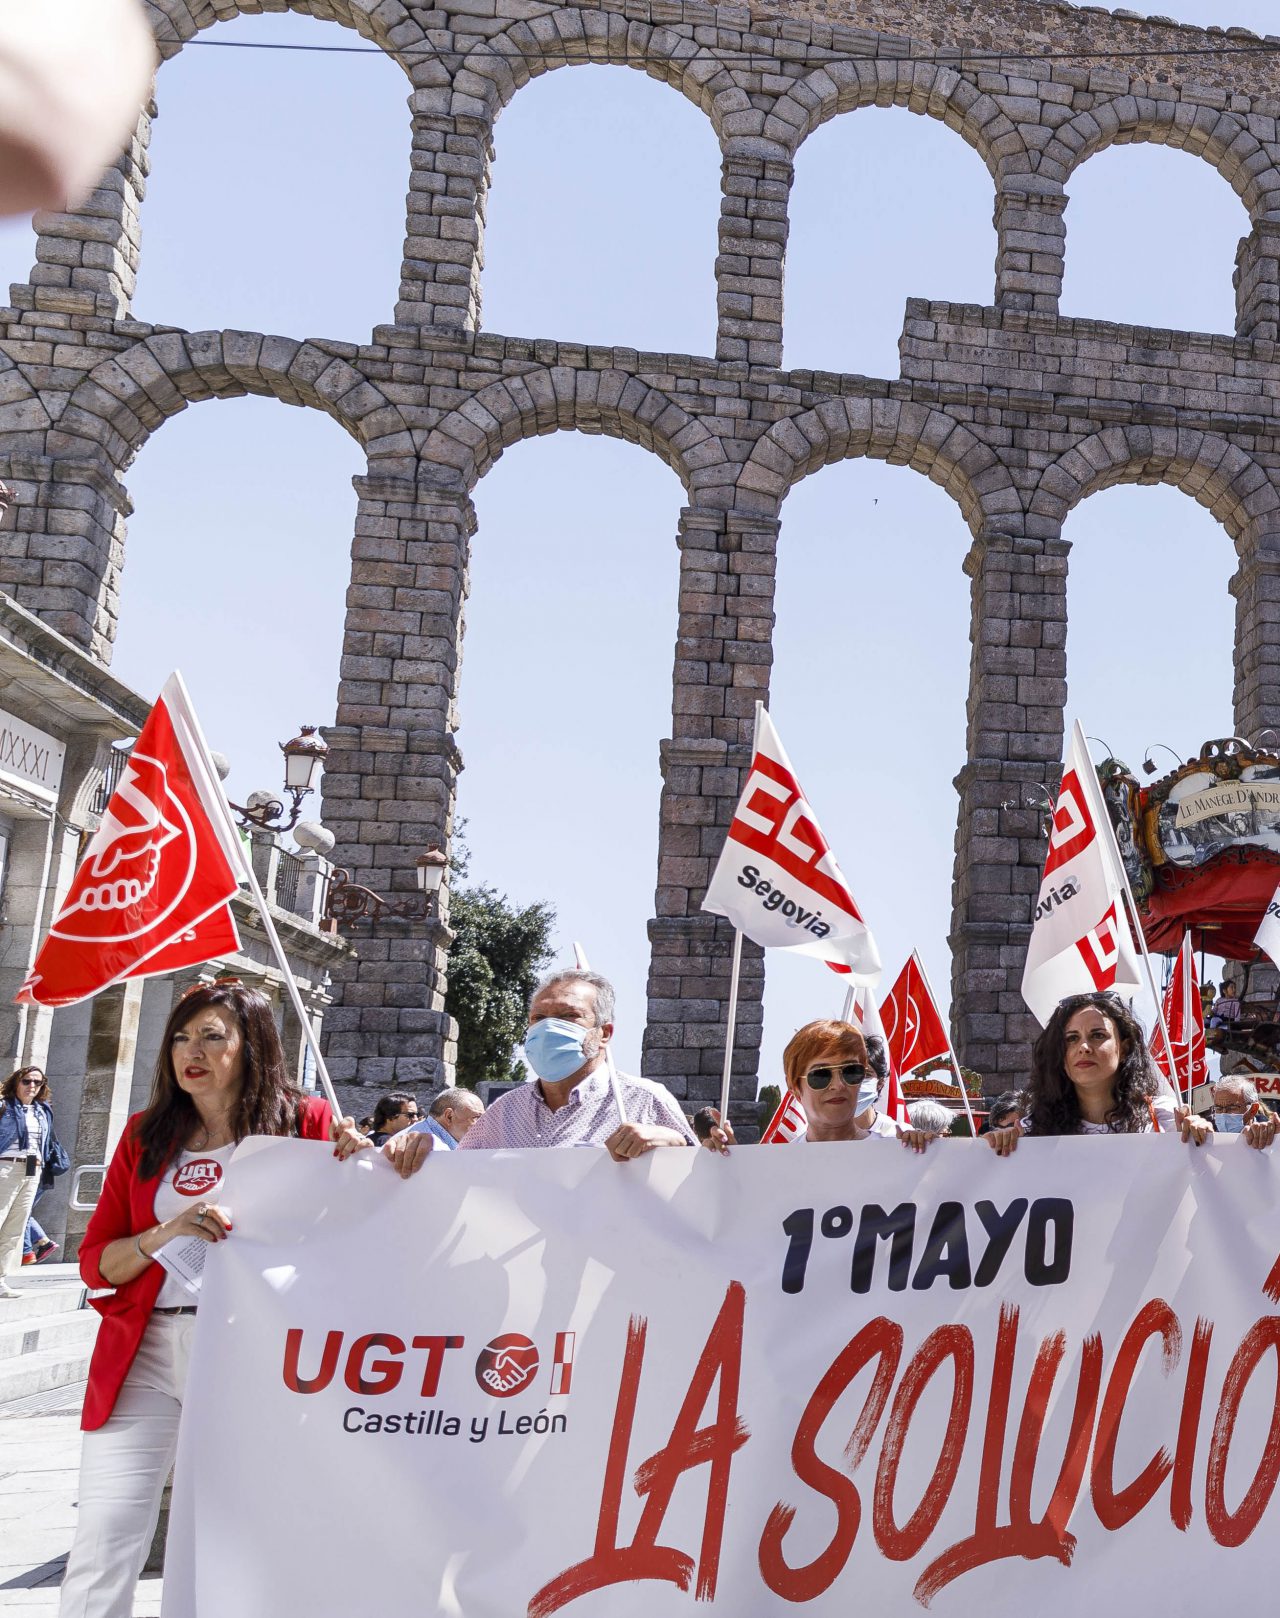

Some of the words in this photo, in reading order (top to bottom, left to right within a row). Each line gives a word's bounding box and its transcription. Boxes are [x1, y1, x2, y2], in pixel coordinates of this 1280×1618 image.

[1180, 805, 1194, 819] LE
[737, 864, 831, 939] Segovia
[1034, 880, 1078, 923] ovia
[178, 1162, 218, 1181] UGT
[282, 1328, 464, 1398] UGT
[343, 1407, 461, 1436] Castilla
[469, 1416, 489, 1443] y
[498, 1408, 568, 1435] León
[528, 1280, 751, 1618] LA
